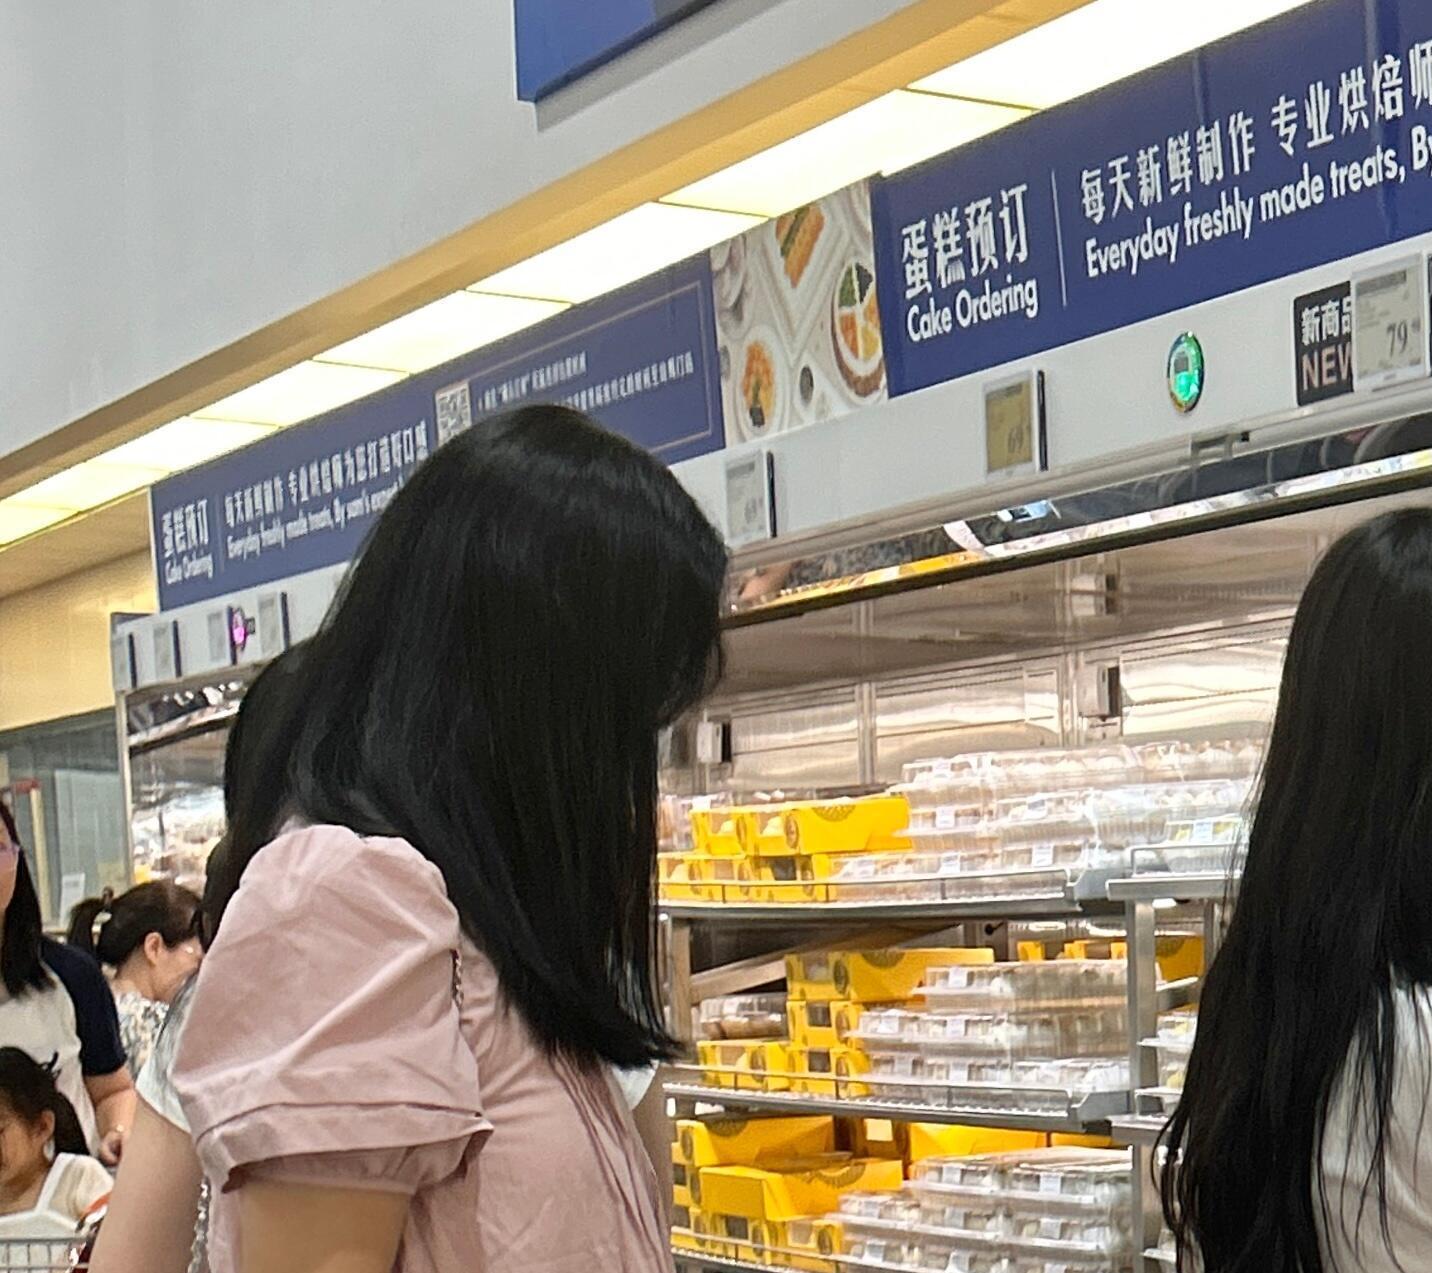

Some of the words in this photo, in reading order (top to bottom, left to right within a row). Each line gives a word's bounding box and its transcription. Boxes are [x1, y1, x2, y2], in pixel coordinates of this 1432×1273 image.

[1080, 111, 1255, 224] 每天新鲜制作
[1085, 216, 1179, 277] Everyday
[1183, 186, 1254, 247] freshly
[1259, 162, 1324, 221] made
[1329, 145, 1406, 198] treats,
[901, 184, 1028, 300] 蛋糕预订
[906, 298, 952, 342] Cake
[955, 274, 1038, 328] Ordering
